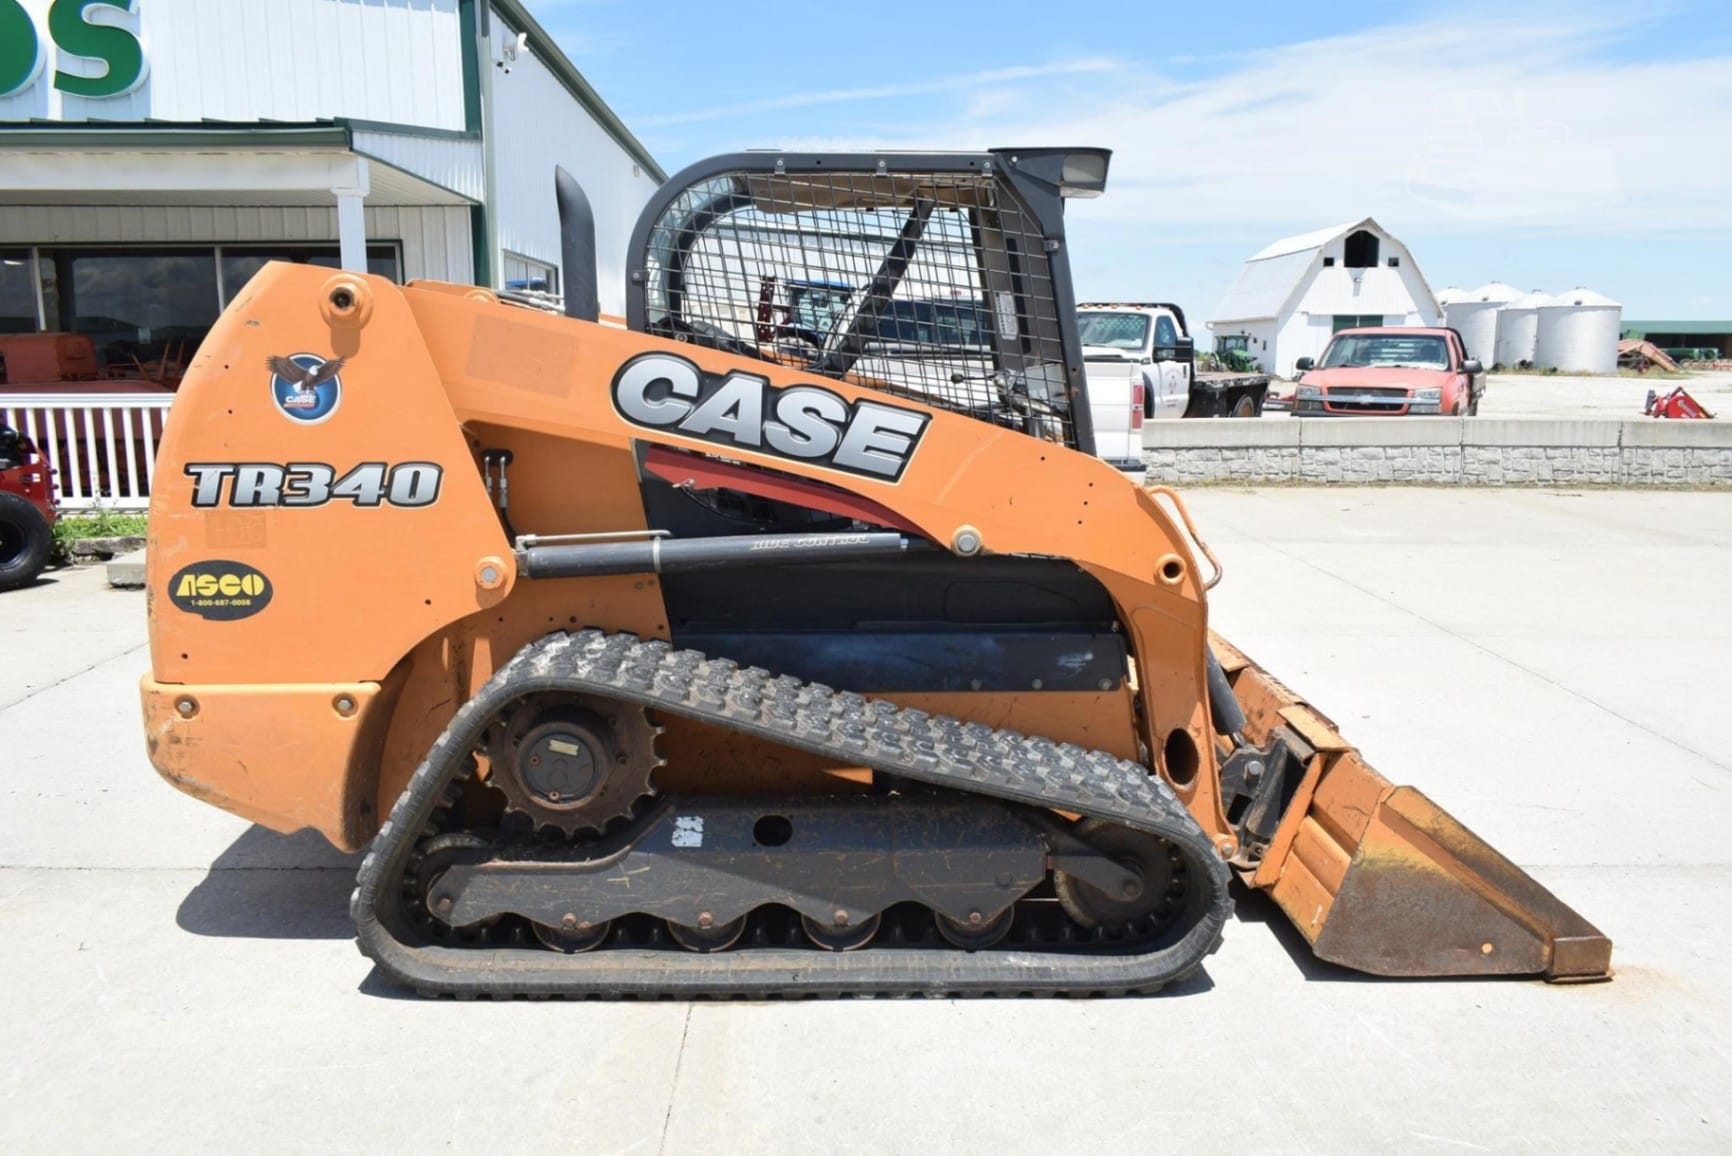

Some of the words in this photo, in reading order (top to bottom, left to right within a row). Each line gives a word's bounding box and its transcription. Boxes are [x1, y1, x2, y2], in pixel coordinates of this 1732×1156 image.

[285, 395, 317, 404] CASE
[613, 352, 931, 481] CASE
[185, 462, 443, 507] TR340
[176, 573, 265, 597] ASCO
